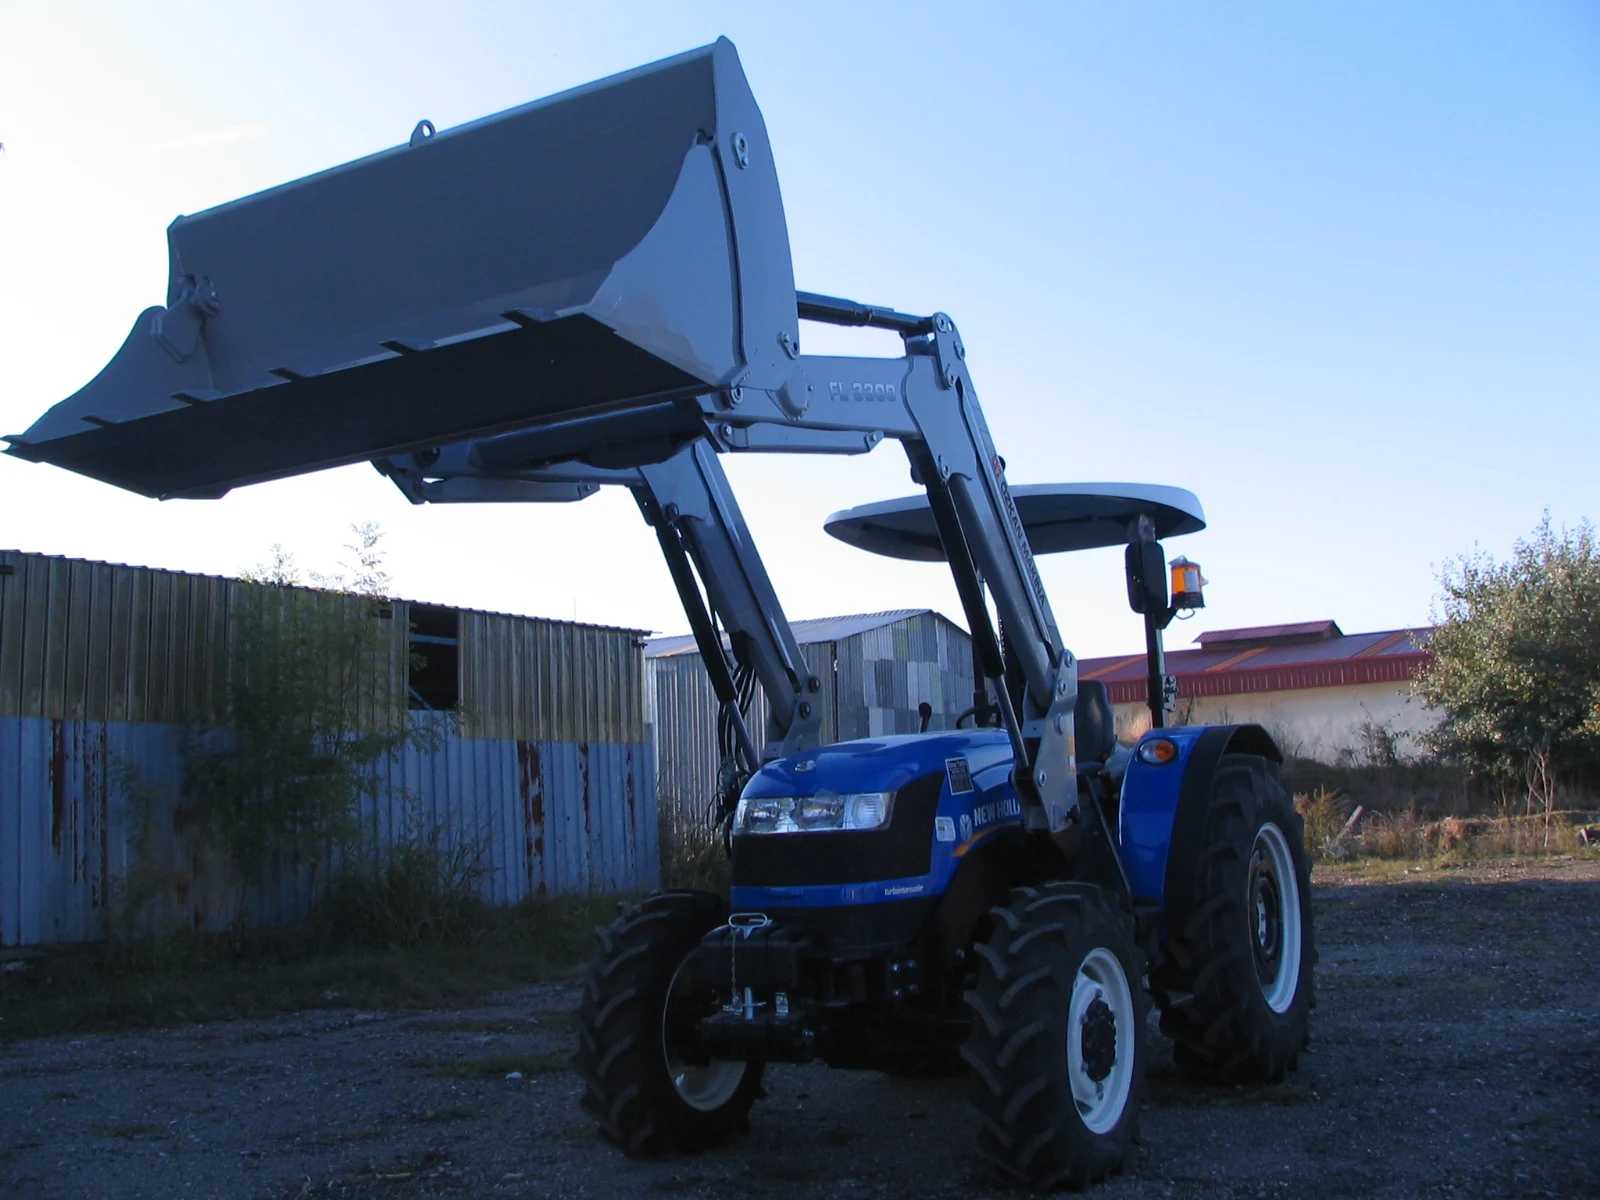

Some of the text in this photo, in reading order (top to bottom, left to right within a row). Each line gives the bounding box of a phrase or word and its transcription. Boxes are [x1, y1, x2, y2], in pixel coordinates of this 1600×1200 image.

[828, 381, 896, 402] FL 3300
[973, 804, 996, 827] NEW
